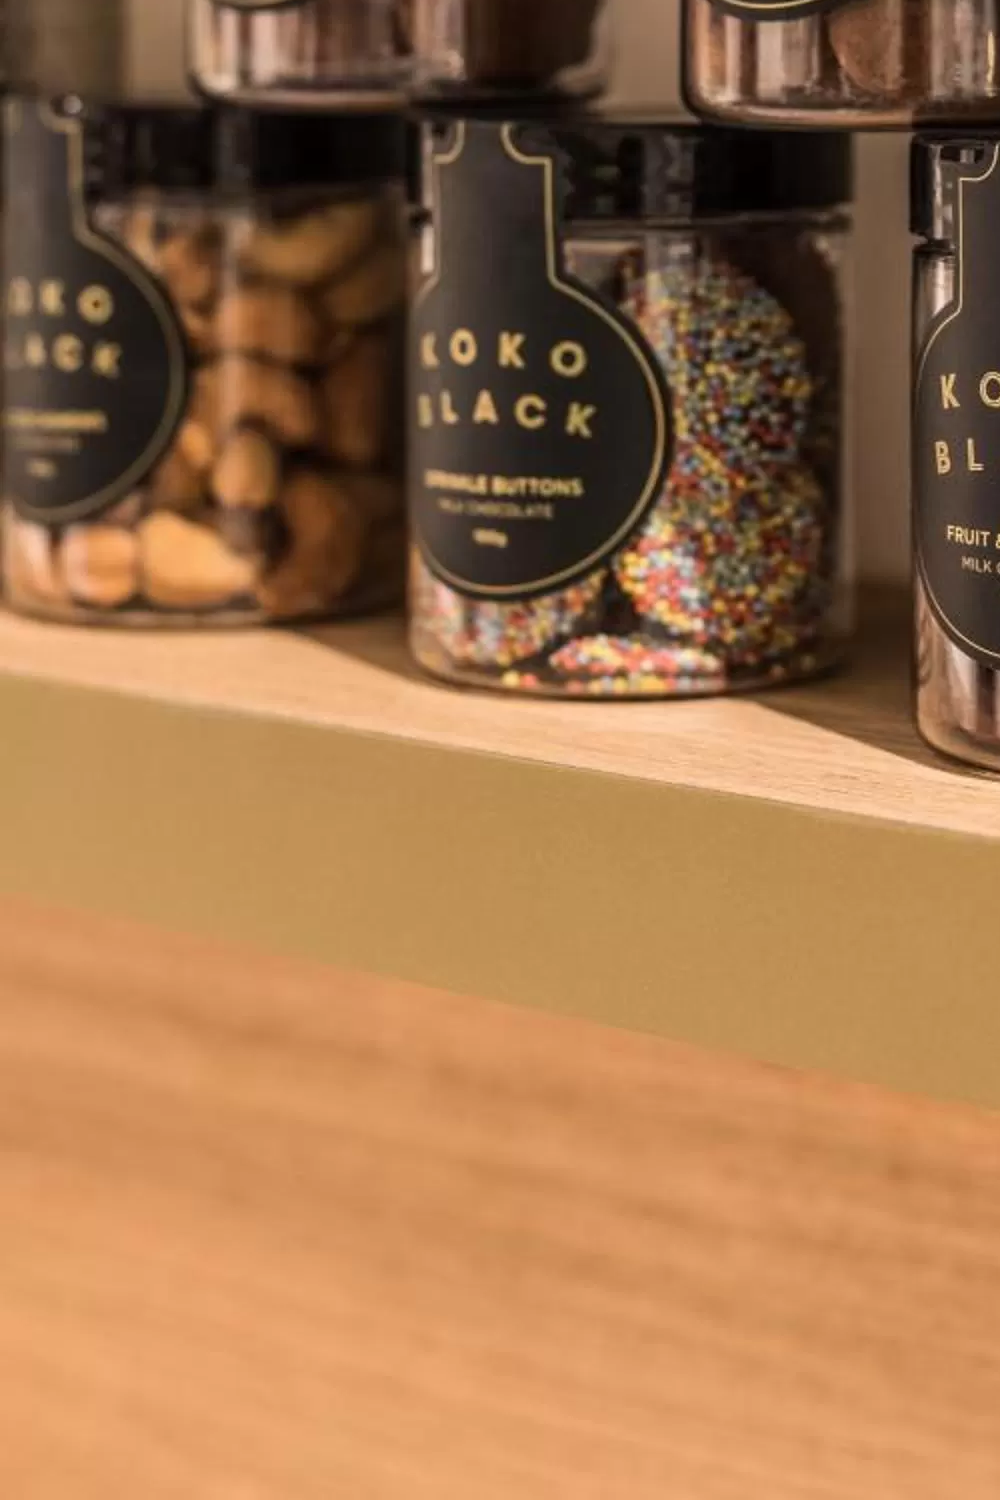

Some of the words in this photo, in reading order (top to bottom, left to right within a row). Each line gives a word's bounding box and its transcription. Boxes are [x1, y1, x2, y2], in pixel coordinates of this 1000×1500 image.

[420, 328, 587, 377] KOKO
[946, 524, 991, 547] FRUIT
[961, 555, 992, 573] MILK
